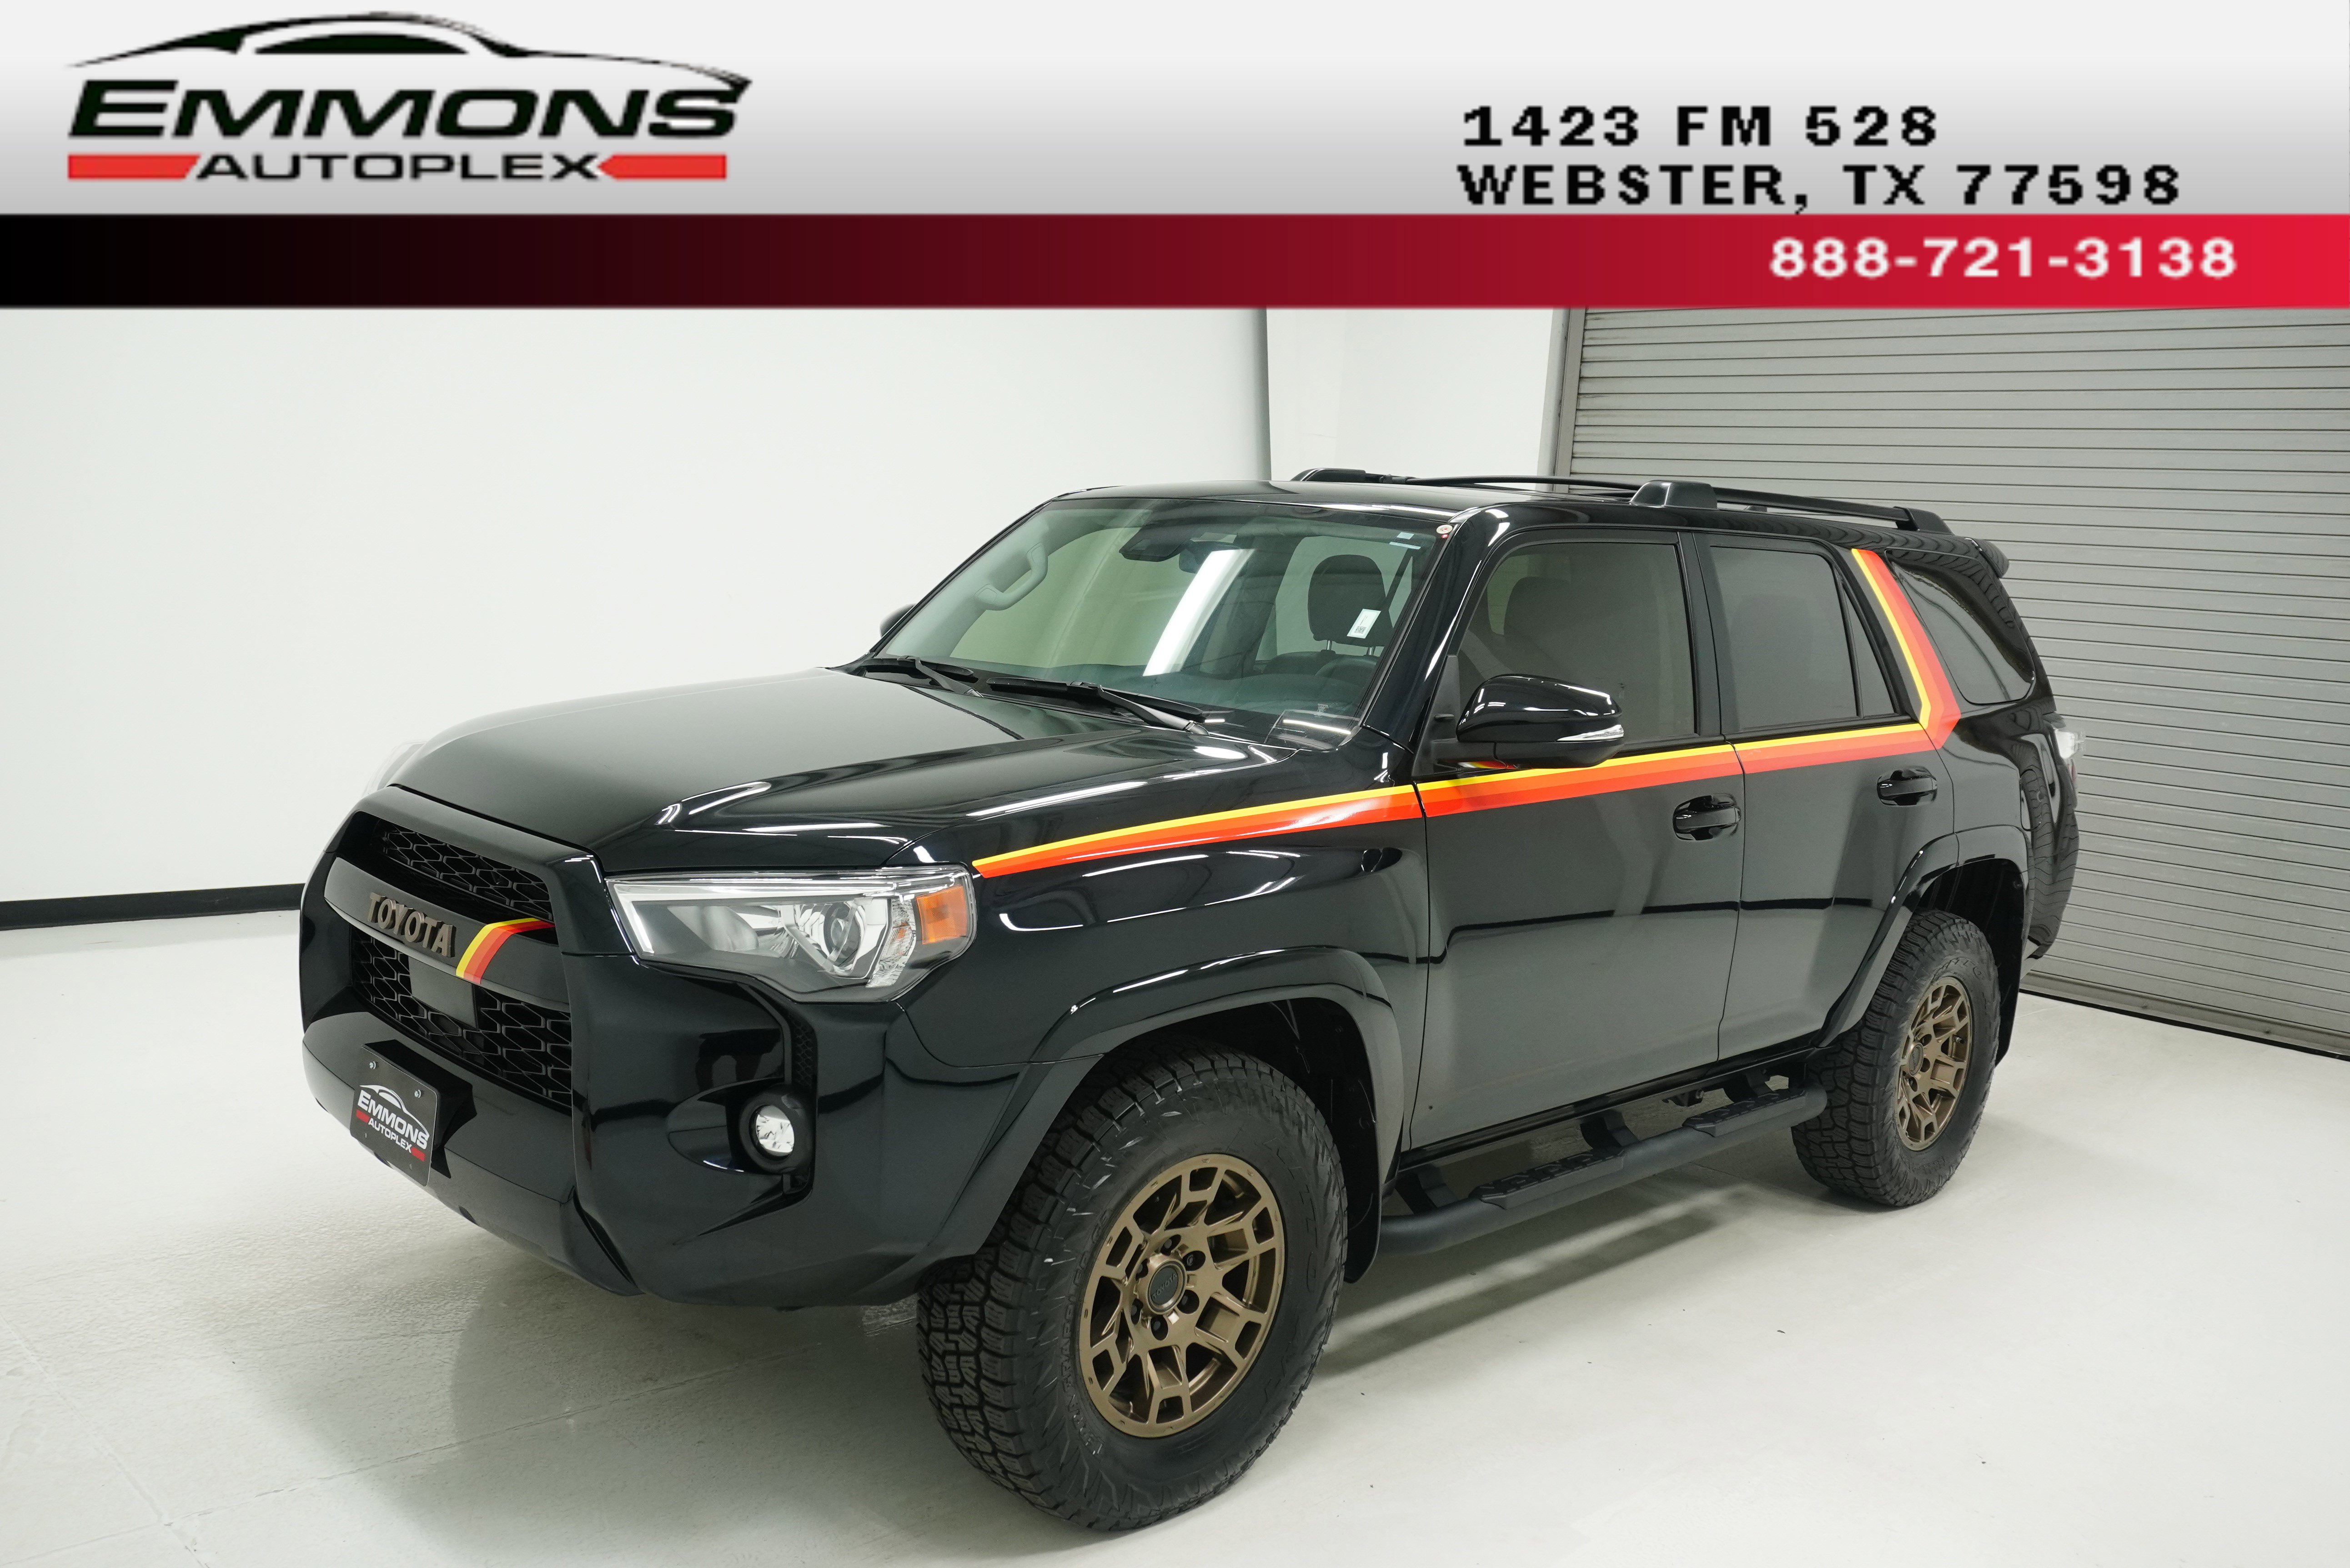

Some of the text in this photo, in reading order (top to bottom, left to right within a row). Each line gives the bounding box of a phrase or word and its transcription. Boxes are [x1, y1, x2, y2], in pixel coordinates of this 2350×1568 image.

[367, 892, 456, 957] TOYOTA
[357, 1090, 428, 1150] EMMONS
[368, 1117, 412, 1154] AUTOPLEX
[1152, 1272, 1177, 1299] TOYOTA
